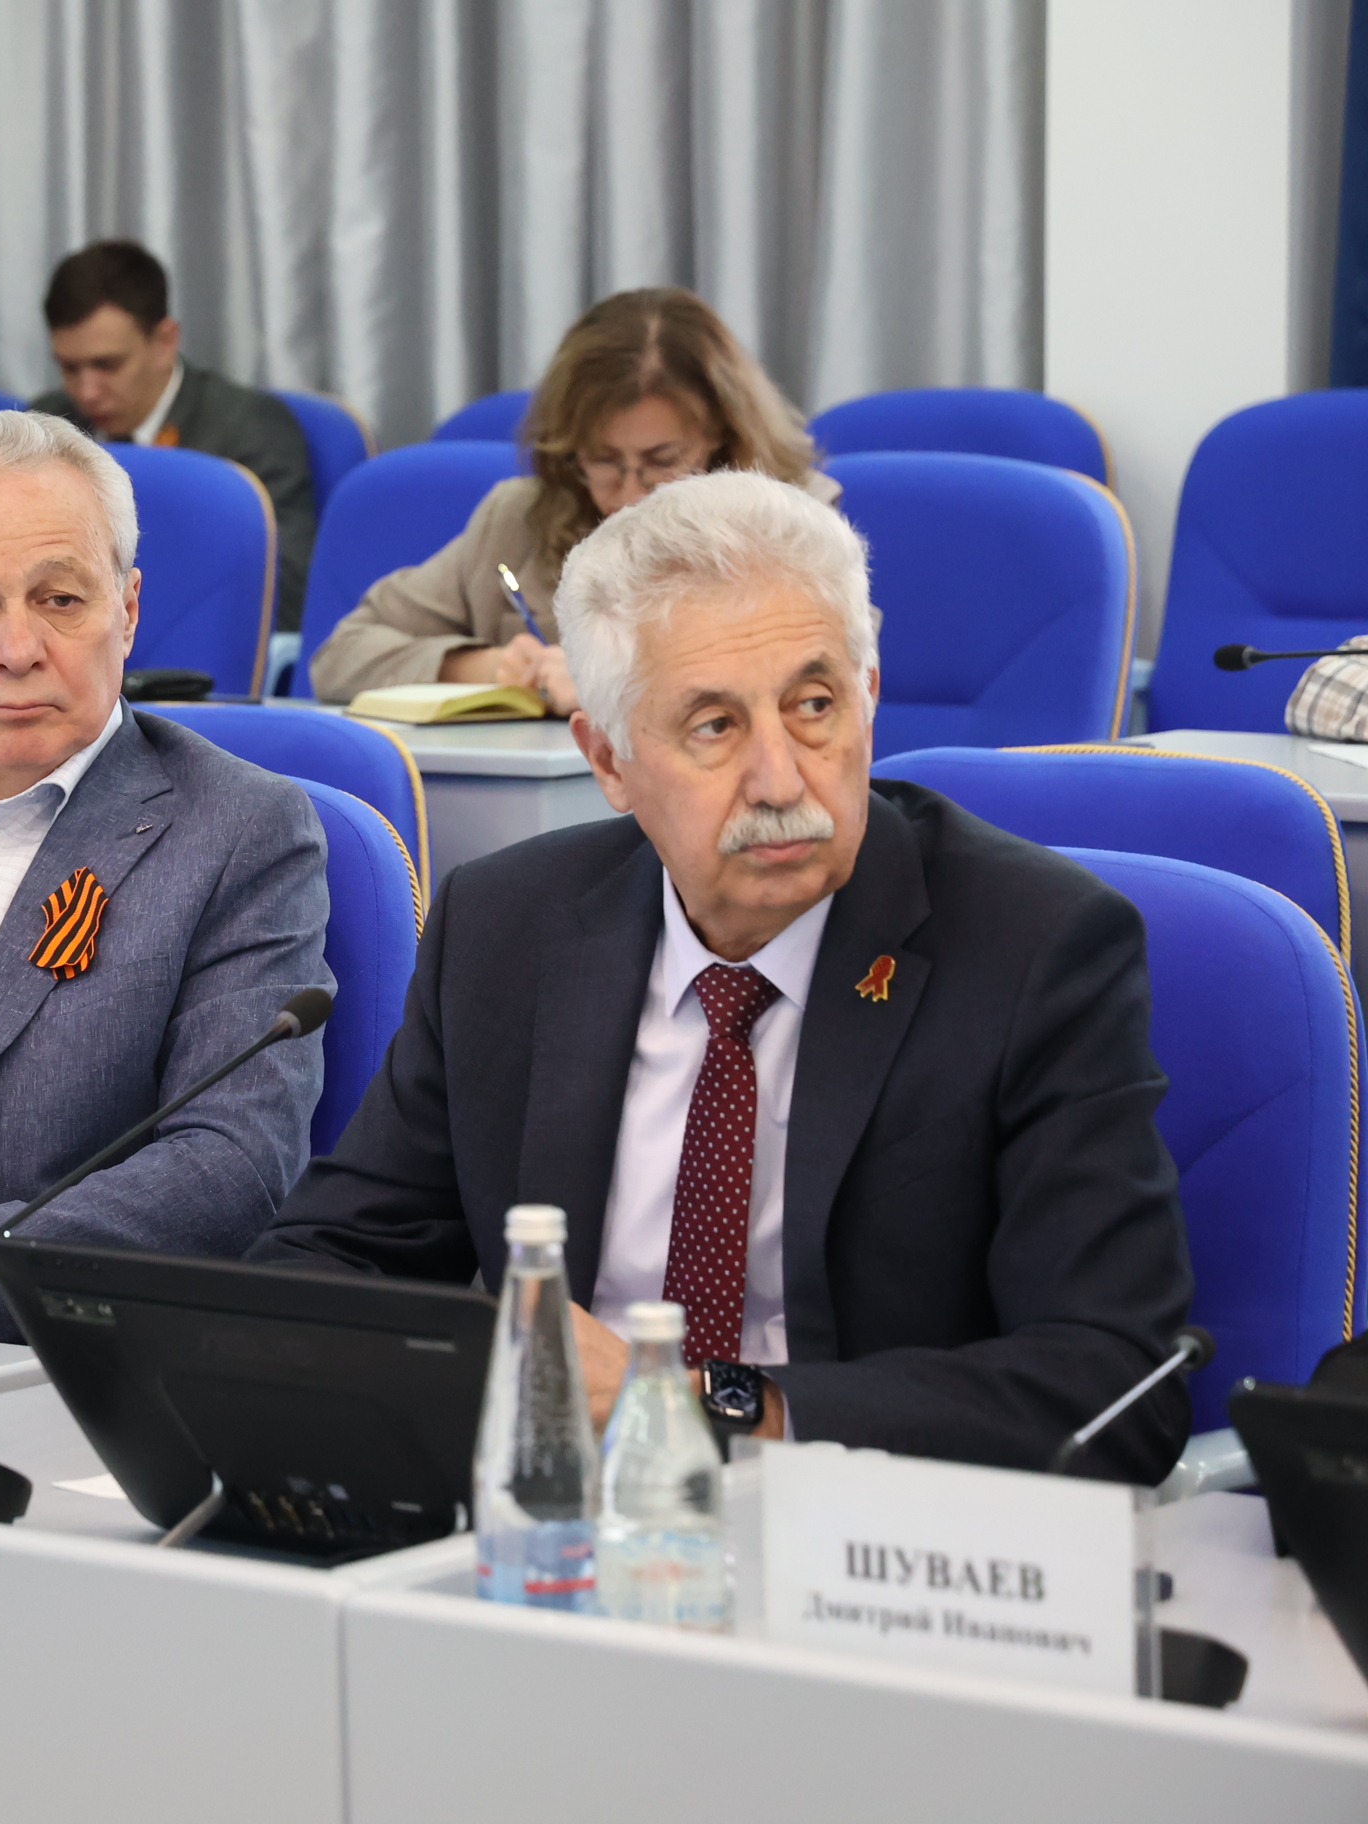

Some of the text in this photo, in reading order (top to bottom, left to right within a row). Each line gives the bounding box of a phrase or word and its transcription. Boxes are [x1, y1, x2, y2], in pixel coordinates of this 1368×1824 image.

[844, 1540, 1046, 1602] ШУВАЕВ
[803, 1590, 1092, 1656] Дмитрий Иванович
